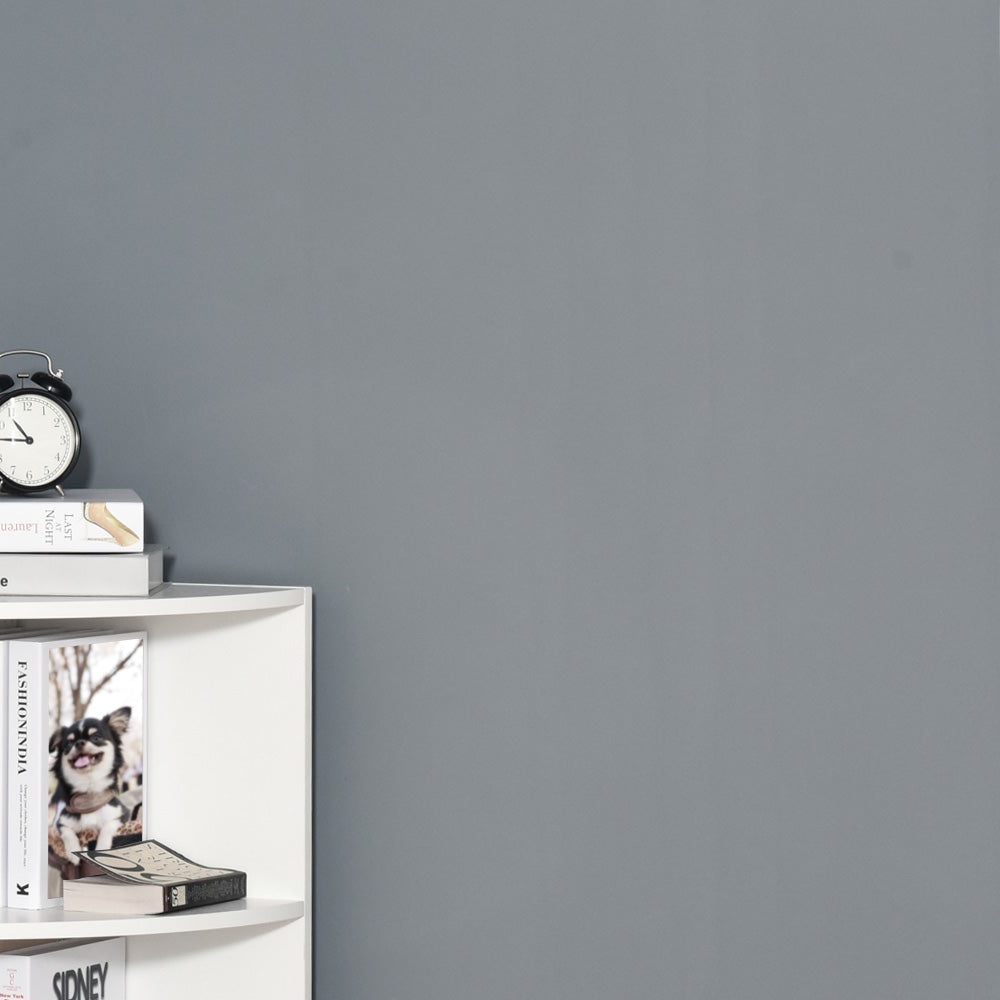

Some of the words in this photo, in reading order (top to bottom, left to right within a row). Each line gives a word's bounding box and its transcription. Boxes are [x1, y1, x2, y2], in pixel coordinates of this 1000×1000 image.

[22, 401, 33, 412] 12
[41, 405, 46, 416] 1
[53, 417, 60, 428] 2
[60, 435, 67, 446] 3
[54, 452, 60, 462] 4
[10, 465, 17, 475] 7
[26, 470, 33, 480] 6
[44, 465, 50, 475] 5
[0, 522, 39, 535] Lauren
[45, 509, 55, 546] NIGHT
[63, 513, 74, 541] LAST
[17, 661, 28, 775] FASHIONINDIA
